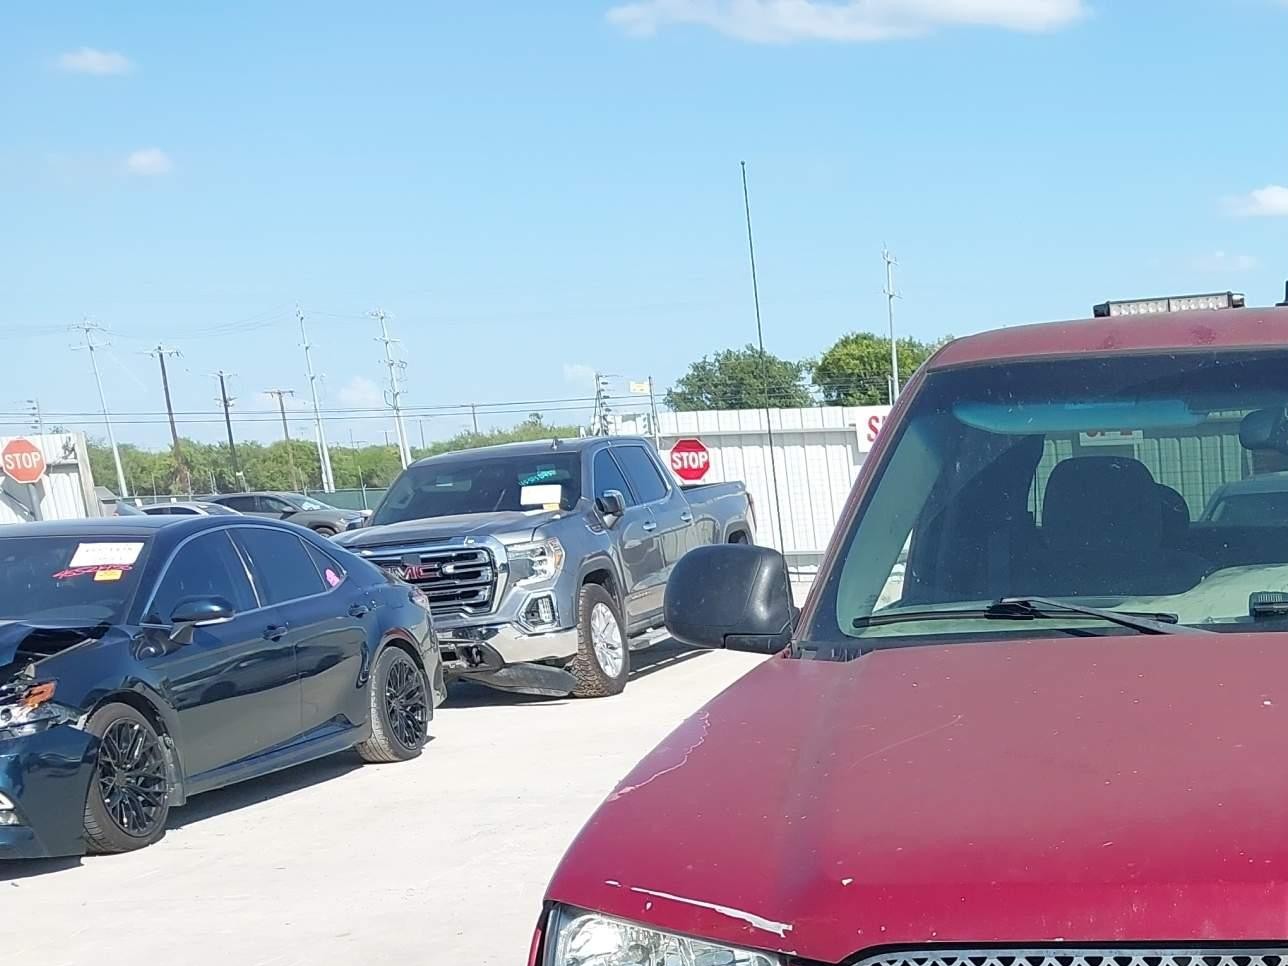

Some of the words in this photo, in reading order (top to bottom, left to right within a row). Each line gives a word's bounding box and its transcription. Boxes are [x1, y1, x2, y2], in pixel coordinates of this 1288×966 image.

[866, 414, 888, 442] S
[4, 451, 41, 470] STOP
[671, 451, 708, 470] STOP
